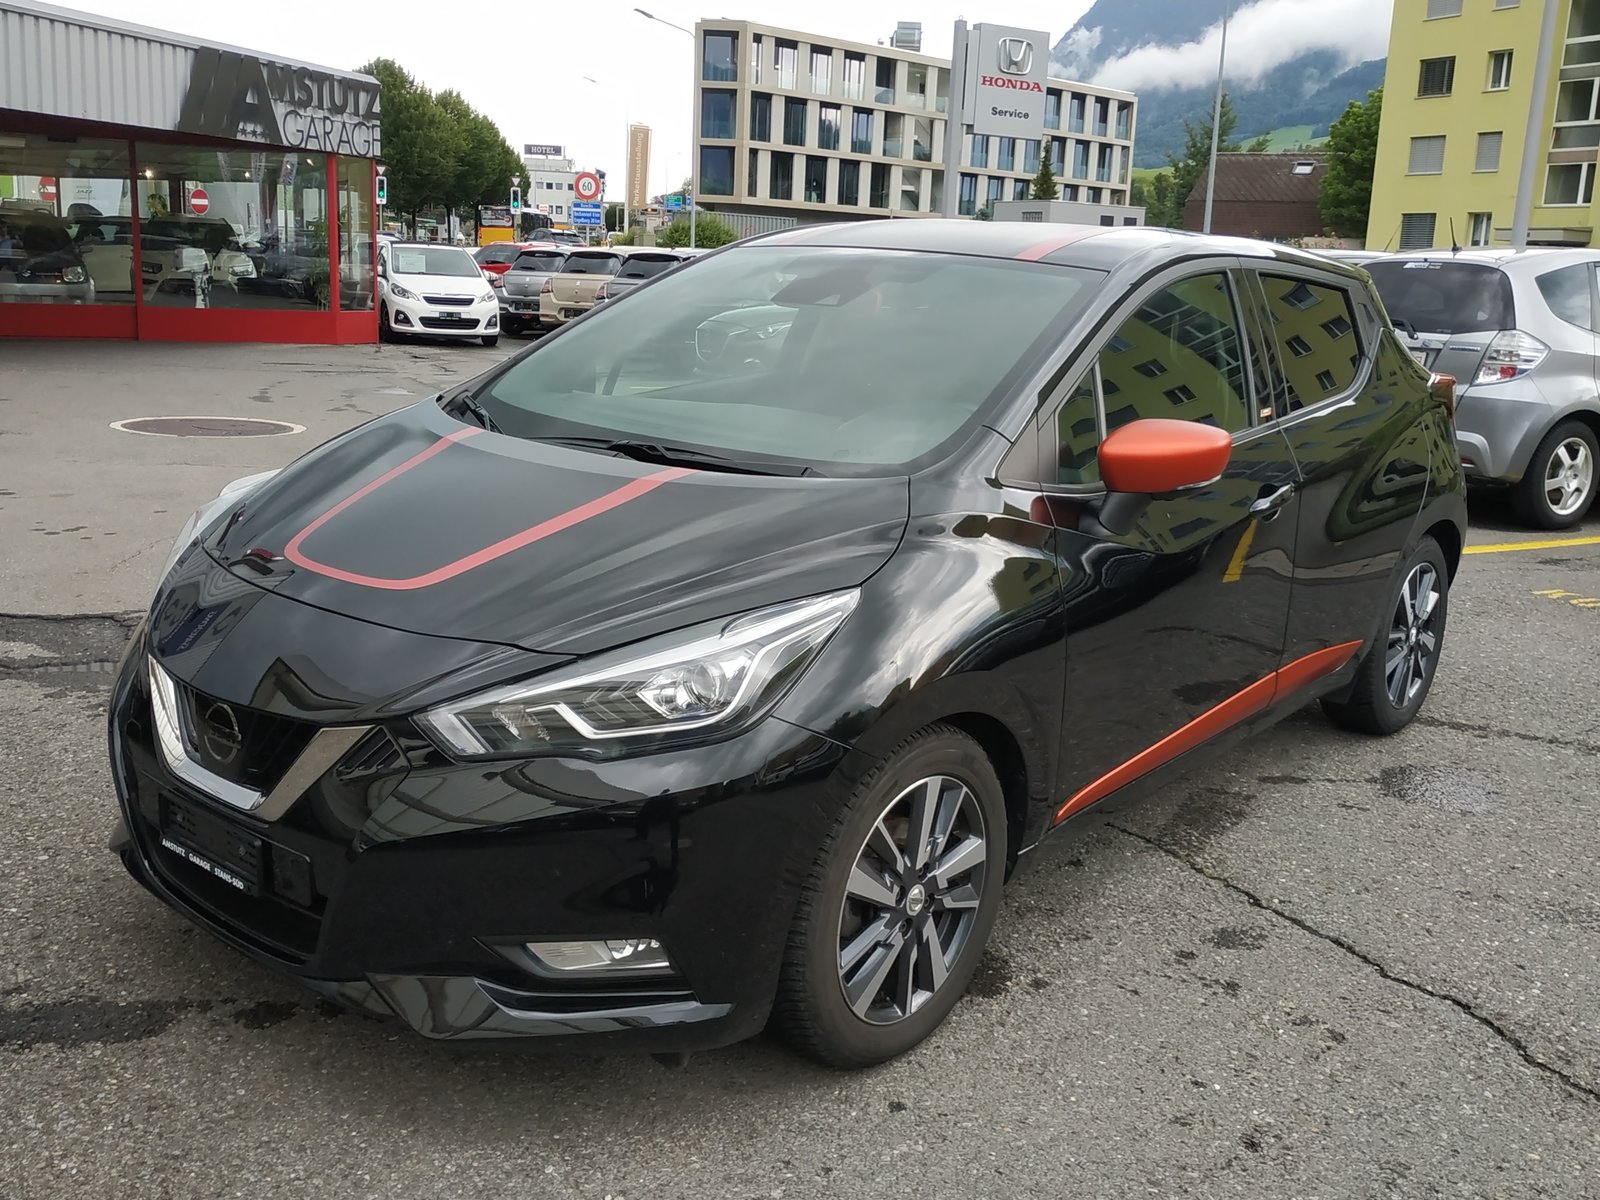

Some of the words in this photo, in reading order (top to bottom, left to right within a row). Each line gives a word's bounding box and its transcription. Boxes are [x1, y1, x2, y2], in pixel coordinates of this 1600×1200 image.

[981, 75, 1043, 92] HONDA
[222, 54, 381, 144] AMSTUTZ
[991, 106, 1030, 119] Service
[283, 110, 381, 157] GARAGE
[531, 146, 555, 154] HOTEL
[632, 132, 644, 207] Parkettausstellung
[582, 181, 592, 191] 60
[161, 838, 186, 857] AMSTUTZ
[188, 853, 211, 872] GARAGE
